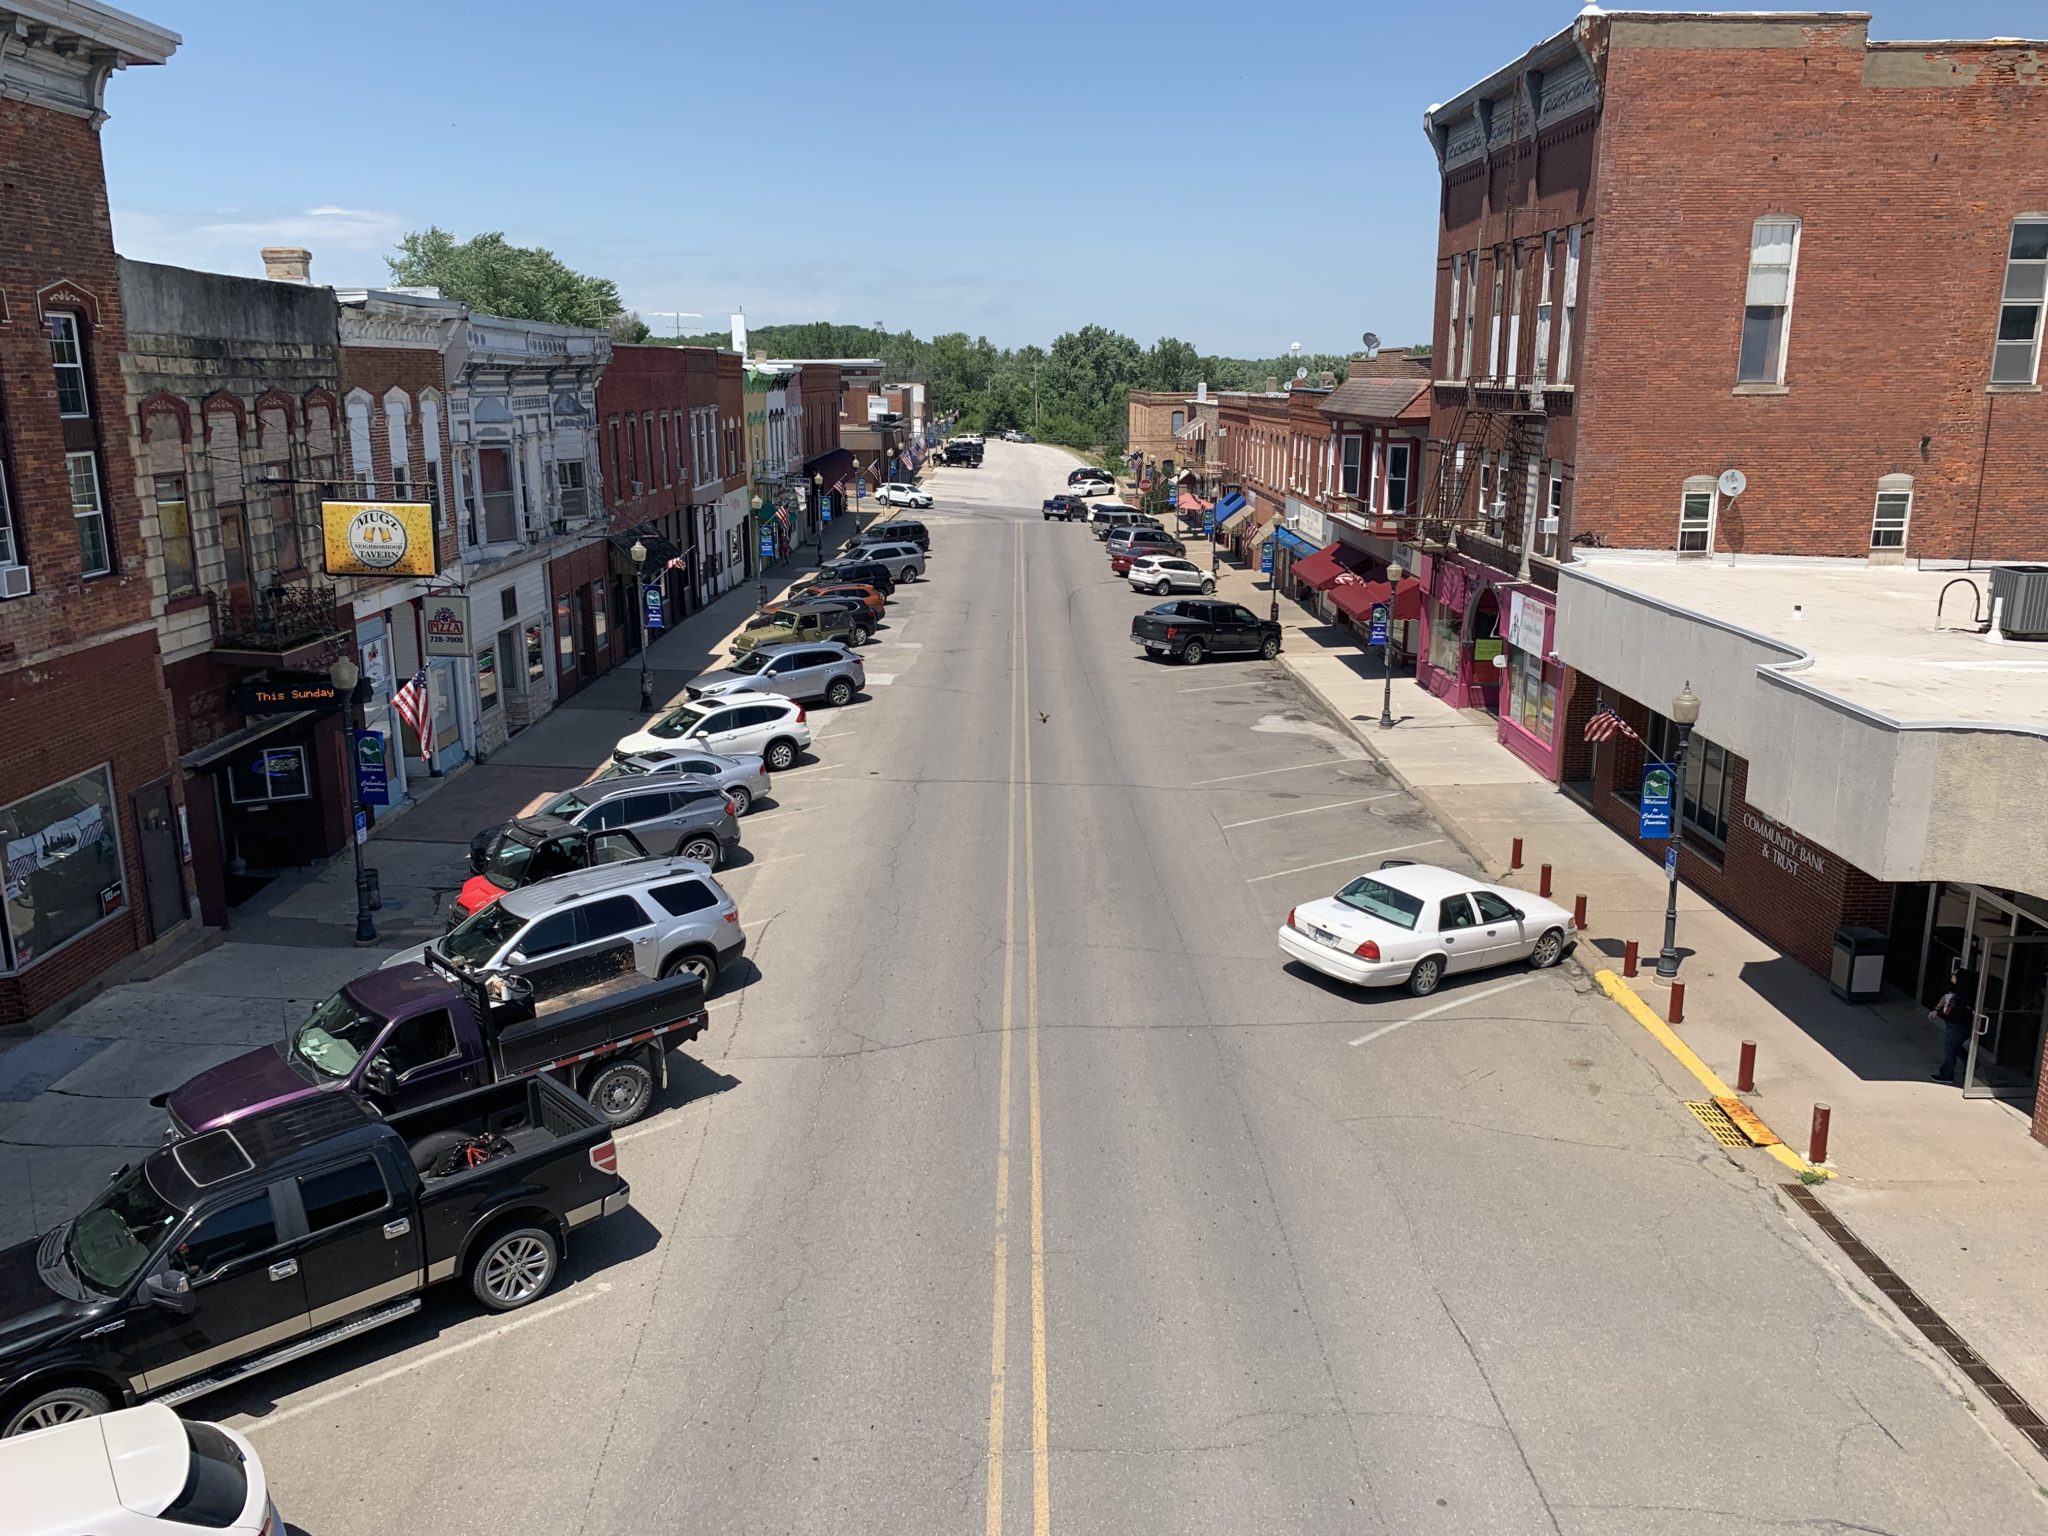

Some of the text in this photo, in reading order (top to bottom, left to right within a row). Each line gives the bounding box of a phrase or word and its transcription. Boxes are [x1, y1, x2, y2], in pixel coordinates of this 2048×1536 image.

[359, 550, 399, 558] TAVERN
[430, 622, 461, 633] PIZZA
[256, 688, 335, 701] This Sunday
[1744, 813, 1798, 856] COMMUNITY
[1800, 847, 1826, 874] BANK
[1762, 843, 1800, 876] & TRUST
